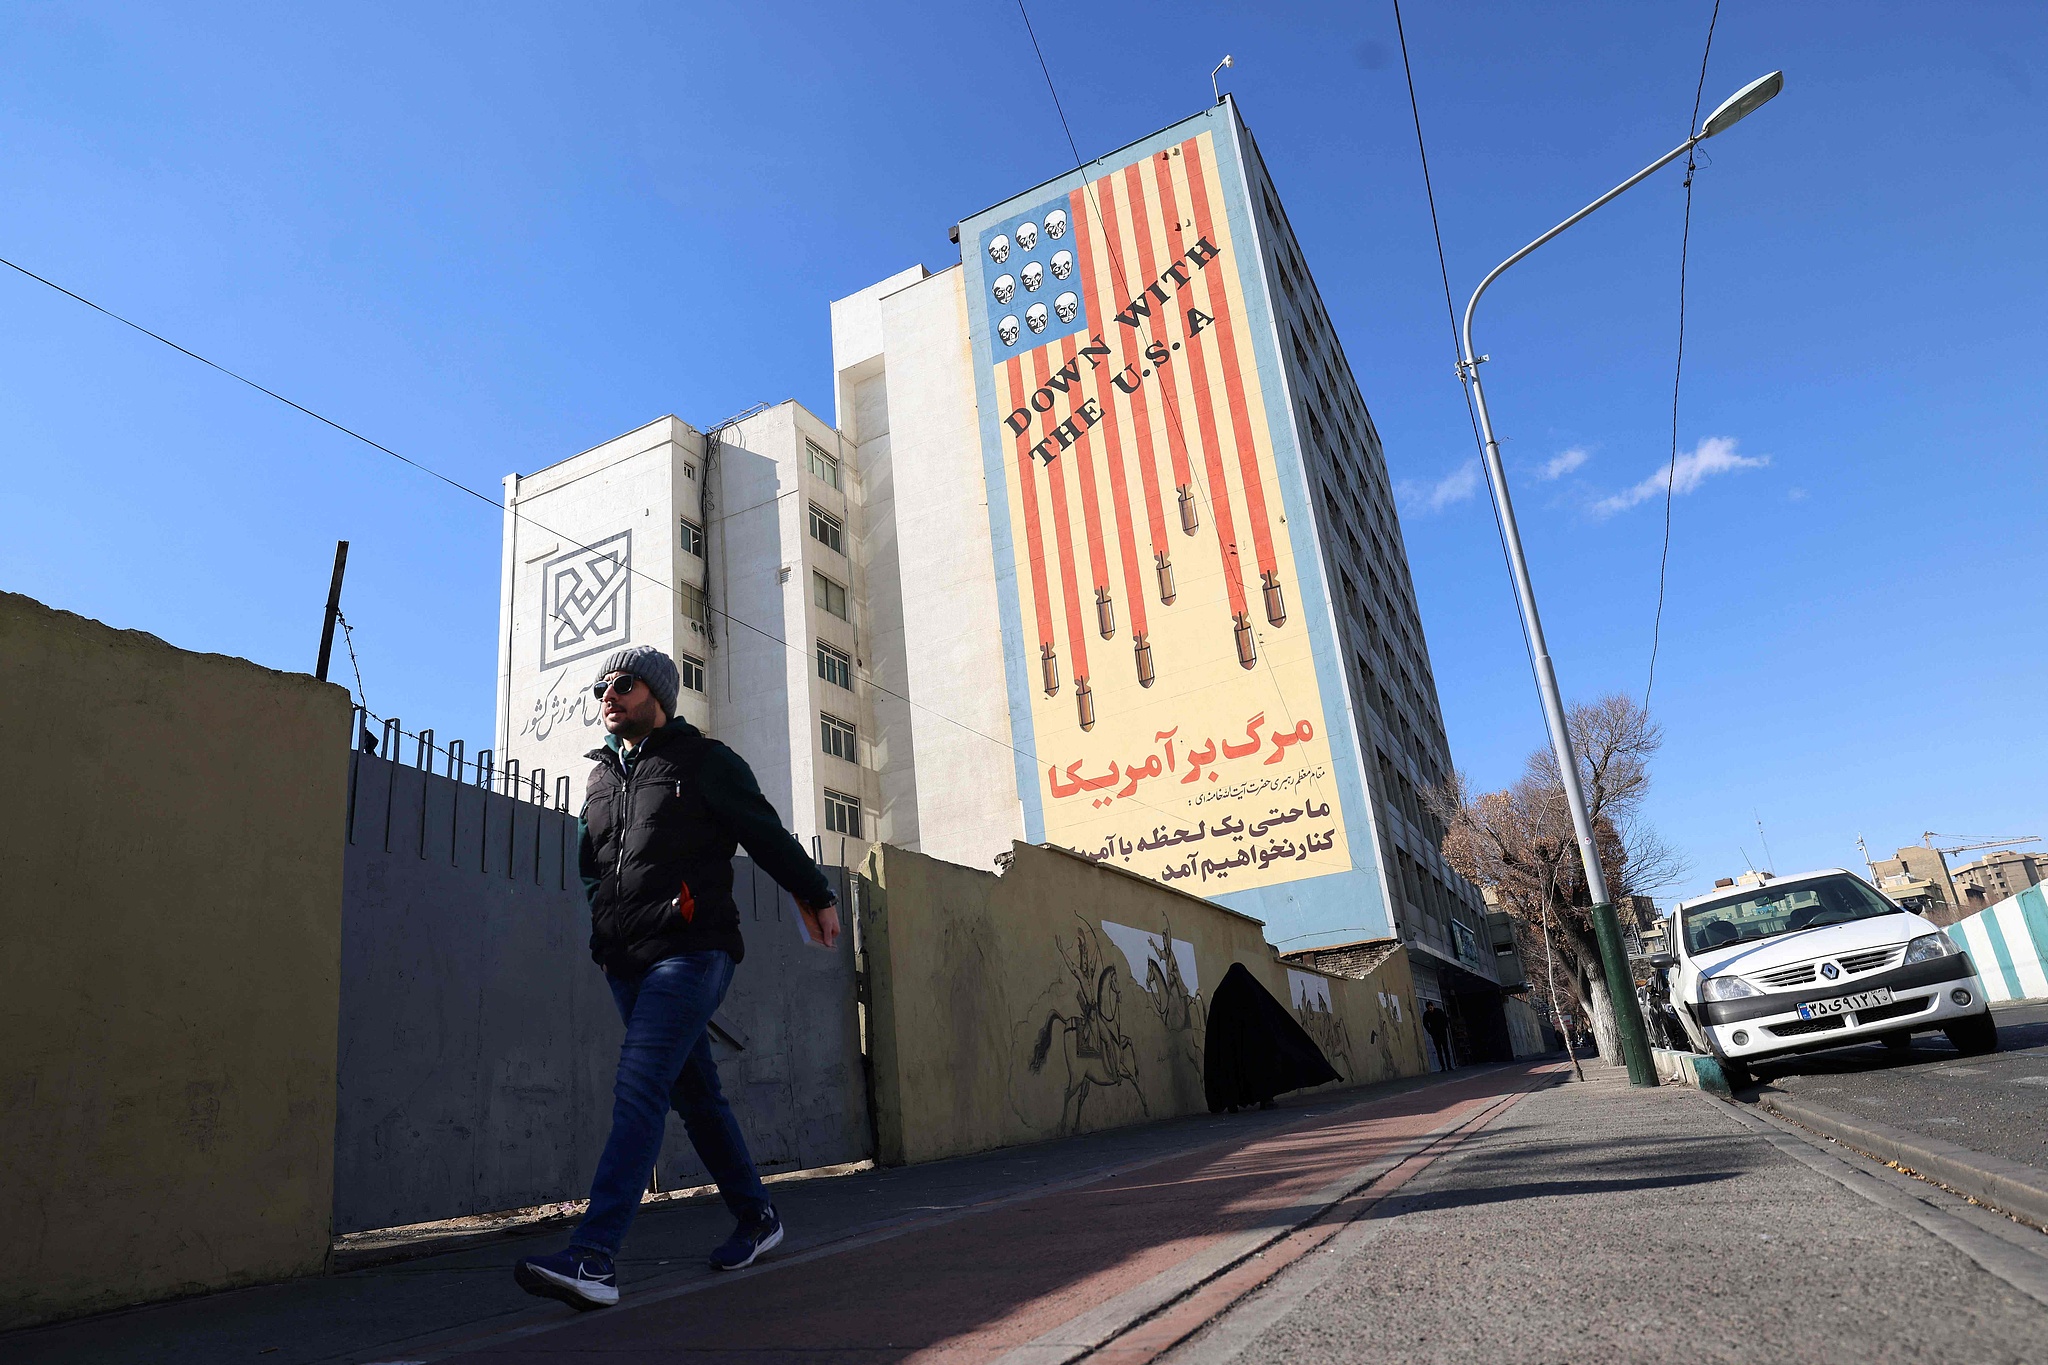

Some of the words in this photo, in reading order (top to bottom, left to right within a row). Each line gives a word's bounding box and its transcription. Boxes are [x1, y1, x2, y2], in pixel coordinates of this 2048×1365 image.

[1003, 334, 1112, 439] DOWN
[1114, 236, 1221, 329] WITH
[1028, 398, 1105, 467] THE
[520, 667, 568, 736] کشور
[536, 683, 593, 741] آموزش
[1221, 710, 1314, 766] مرگ
[1048, 725, 1179, 809] آمریکا
[1180, 737, 1219, 785] بر
[1309, 766, 1326, 787] مقام
[1246, 778, 1271, 797] حضرت
[1270, 775, 1295, 792] رهبری
[1295, 769, 1311, 795] معظم
[1248, 807, 1304, 837] حتی
[1305, 798, 1330, 818] ما
[1137, 820, 1206, 852] لحظه
[1210, 815, 1245, 842] یک
[1118, 834, 1133, 863] با
[1201, 838, 1296, 882] نخواهیم
[1295, 829, 1335, 861] کنار
[1161, 850, 1199, 882] آمد
